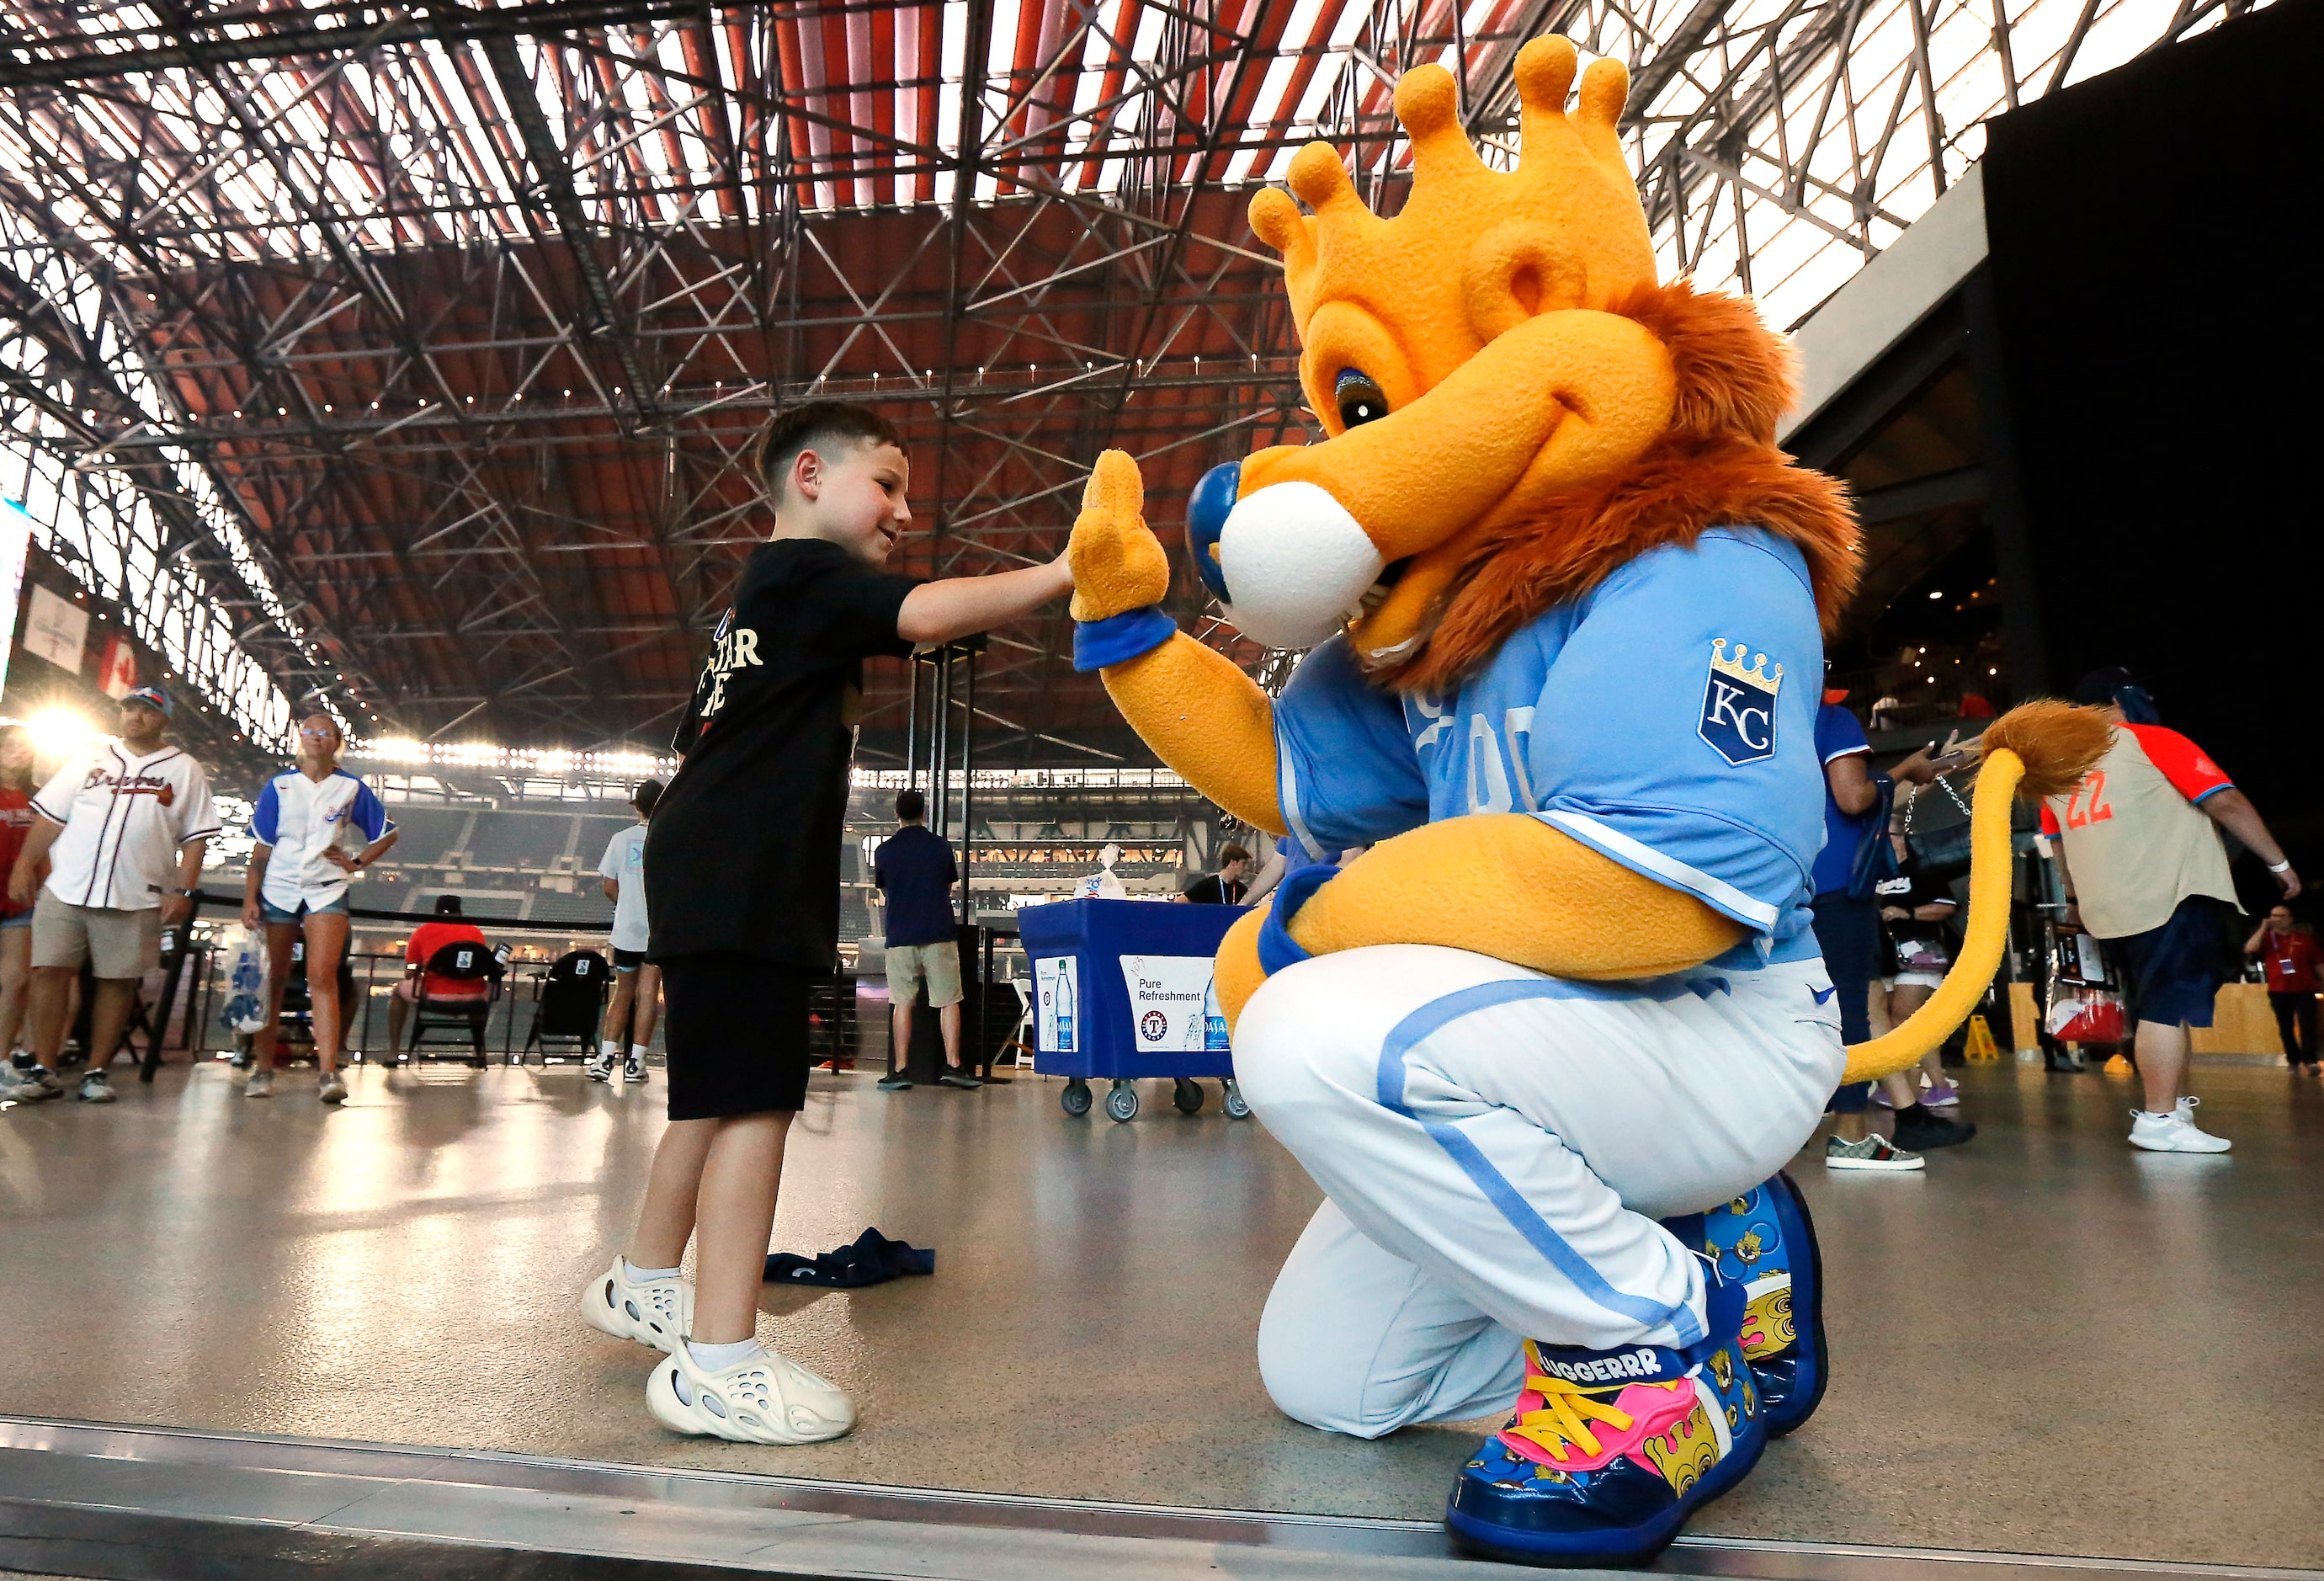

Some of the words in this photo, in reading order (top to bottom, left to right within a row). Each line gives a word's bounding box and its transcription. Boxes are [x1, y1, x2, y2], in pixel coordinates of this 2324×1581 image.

[1707, 679, 1768, 750] KC
[2066, 769, 2113, 830] 22
[1139, 978, 1162, 988] Pure
[1139, 991, 1200, 1001] Refreshment
